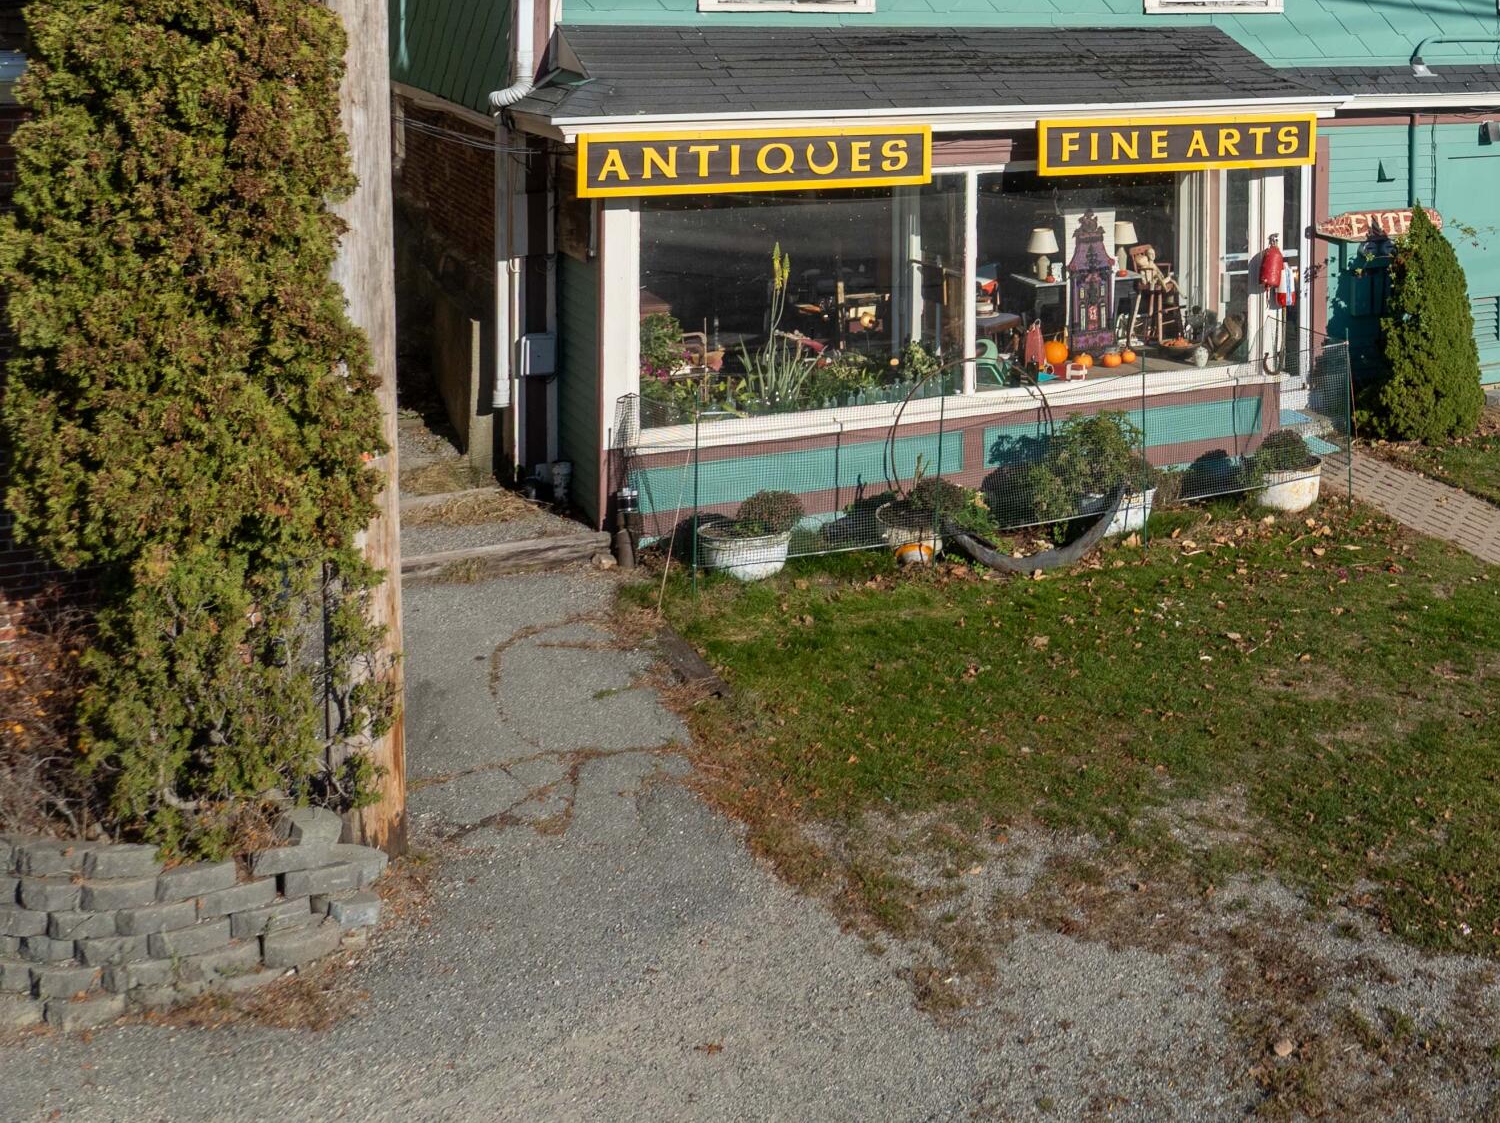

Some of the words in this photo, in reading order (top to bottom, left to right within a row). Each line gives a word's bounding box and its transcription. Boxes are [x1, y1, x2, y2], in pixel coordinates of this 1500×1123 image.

[598, 140, 908, 182] ANTIQUES
[1060, 130, 1168, 162] FINE
[1186, 126, 1299, 158] ARTS
[1350, 212, 1426, 237] ENTE
